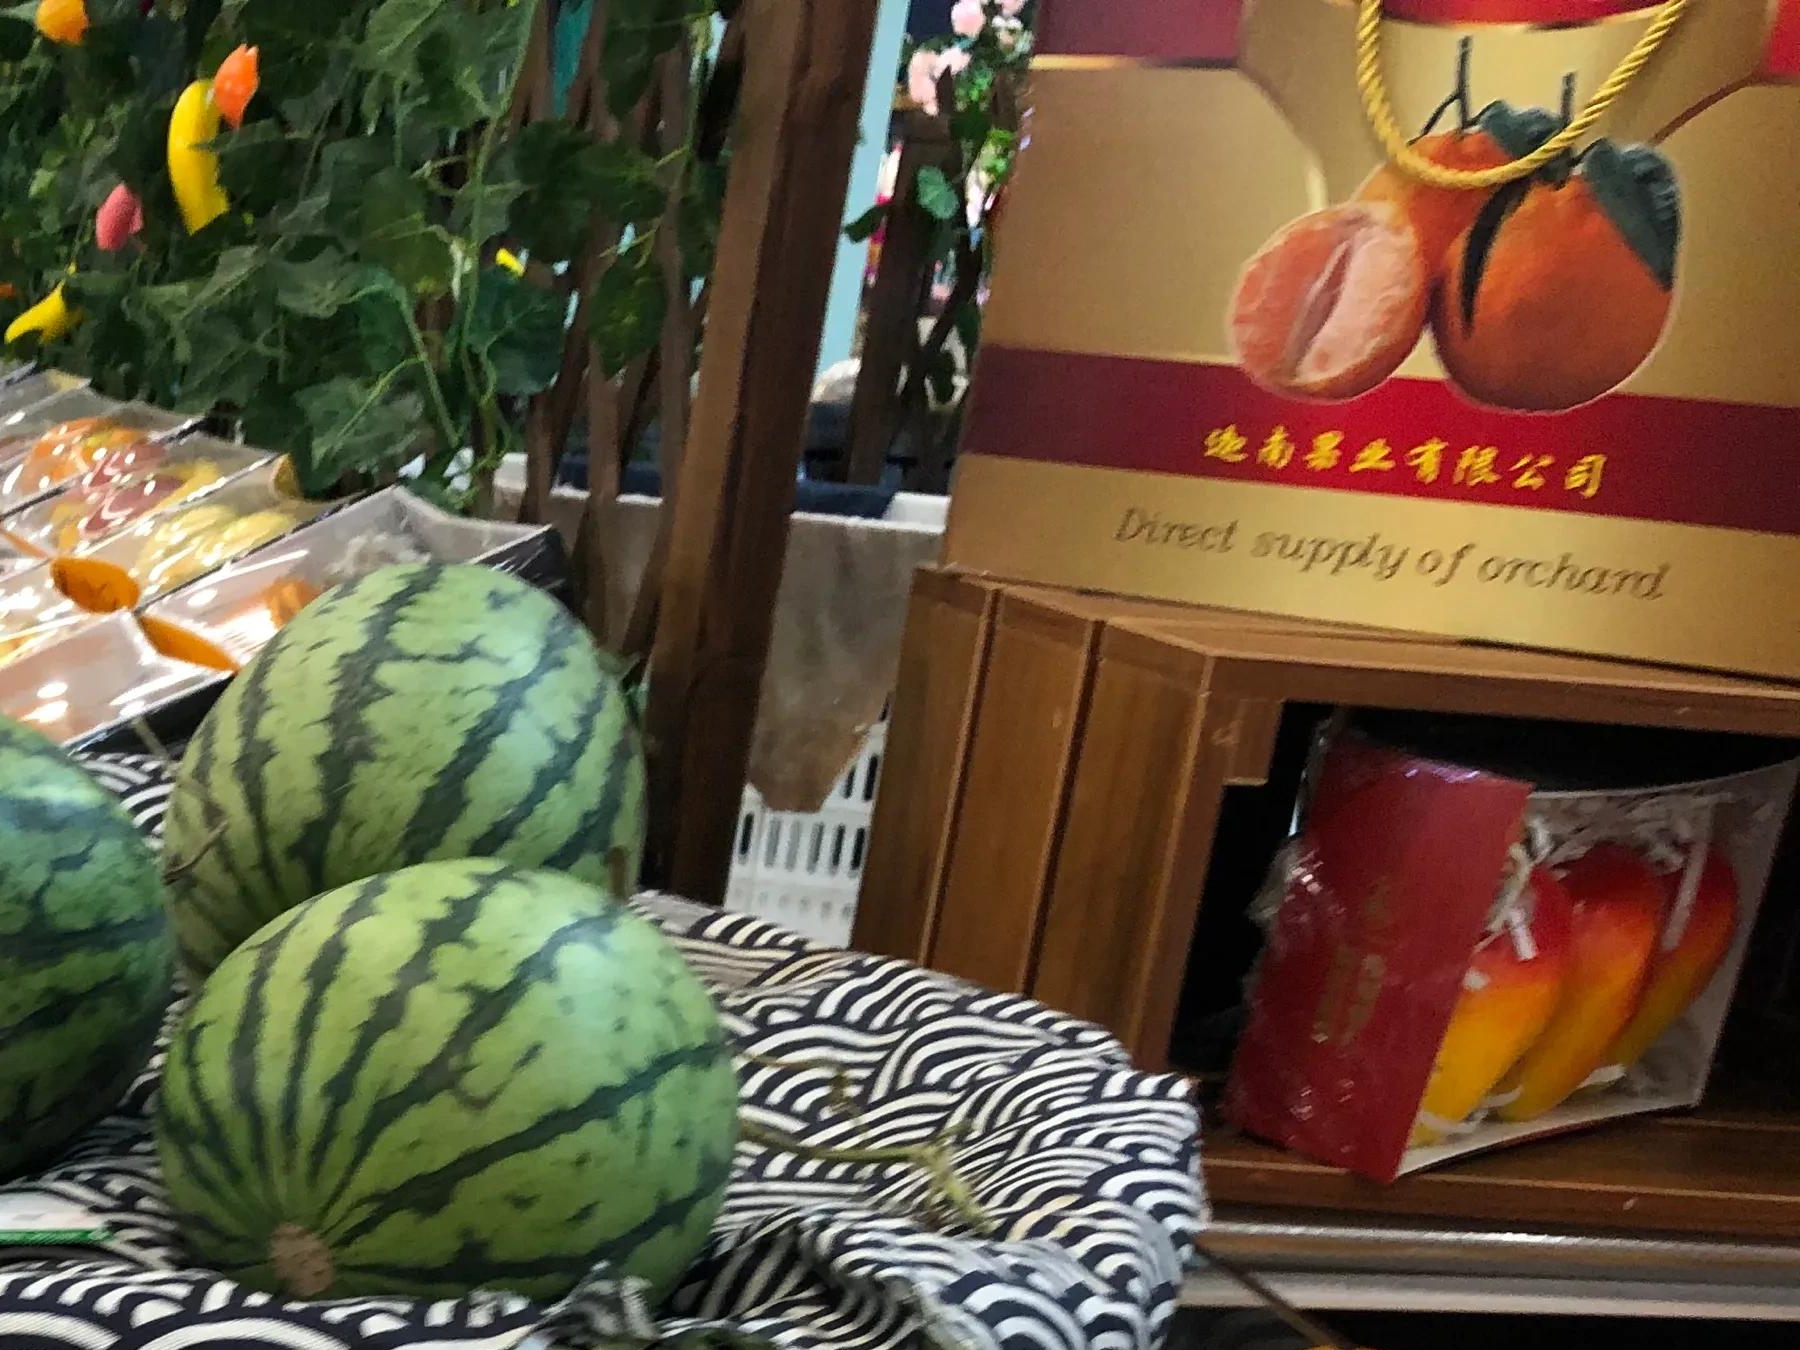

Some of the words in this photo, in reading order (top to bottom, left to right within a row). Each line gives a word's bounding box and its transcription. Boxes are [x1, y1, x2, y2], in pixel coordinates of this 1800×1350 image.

[1113, 506, 1239, 552] Direct
[1251, 532, 1410, 581] supply
[1416, 543, 1476, 587] of
[1477, 552, 1670, 600] orchard
